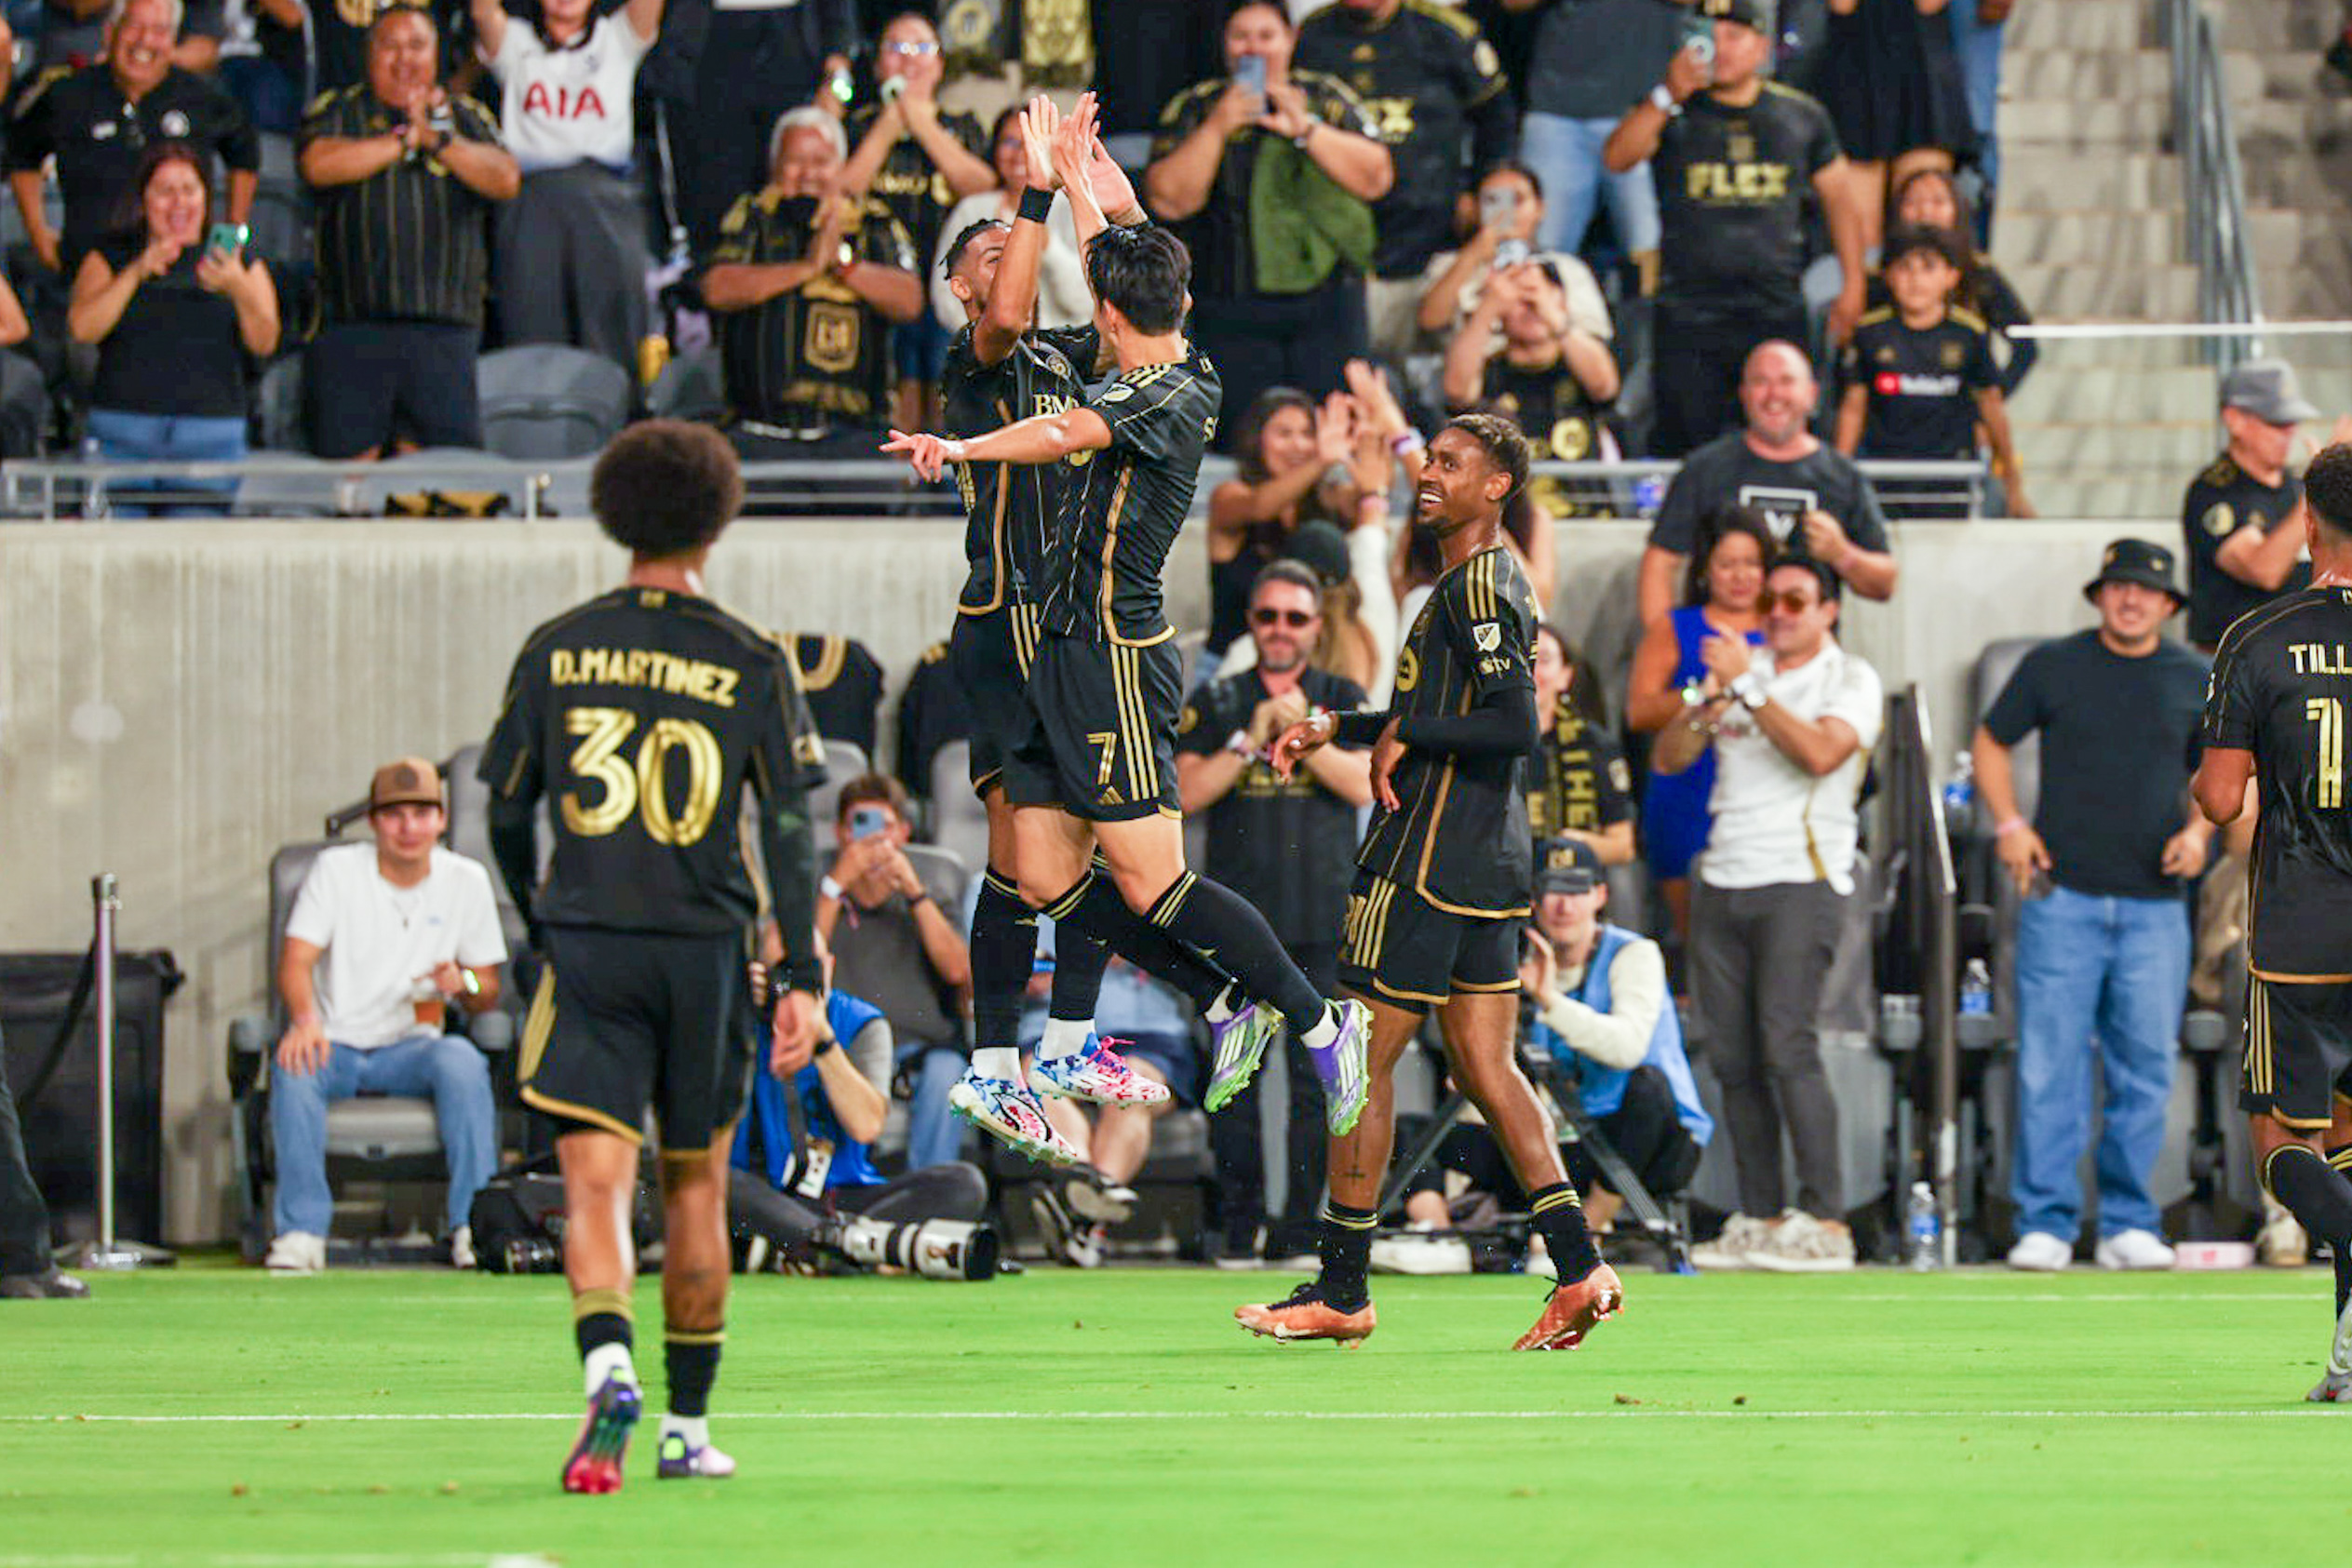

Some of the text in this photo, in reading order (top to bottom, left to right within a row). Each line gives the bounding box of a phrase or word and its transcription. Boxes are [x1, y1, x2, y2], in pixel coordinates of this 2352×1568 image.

[523, 80, 605, 119] AIA
[1687, 162, 1787, 198] FLEX
[550, 648, 740, 707] D.MARTINEZ
[560, 706, 723, 846] 30
[1086, 731, 1117, 785] 7
